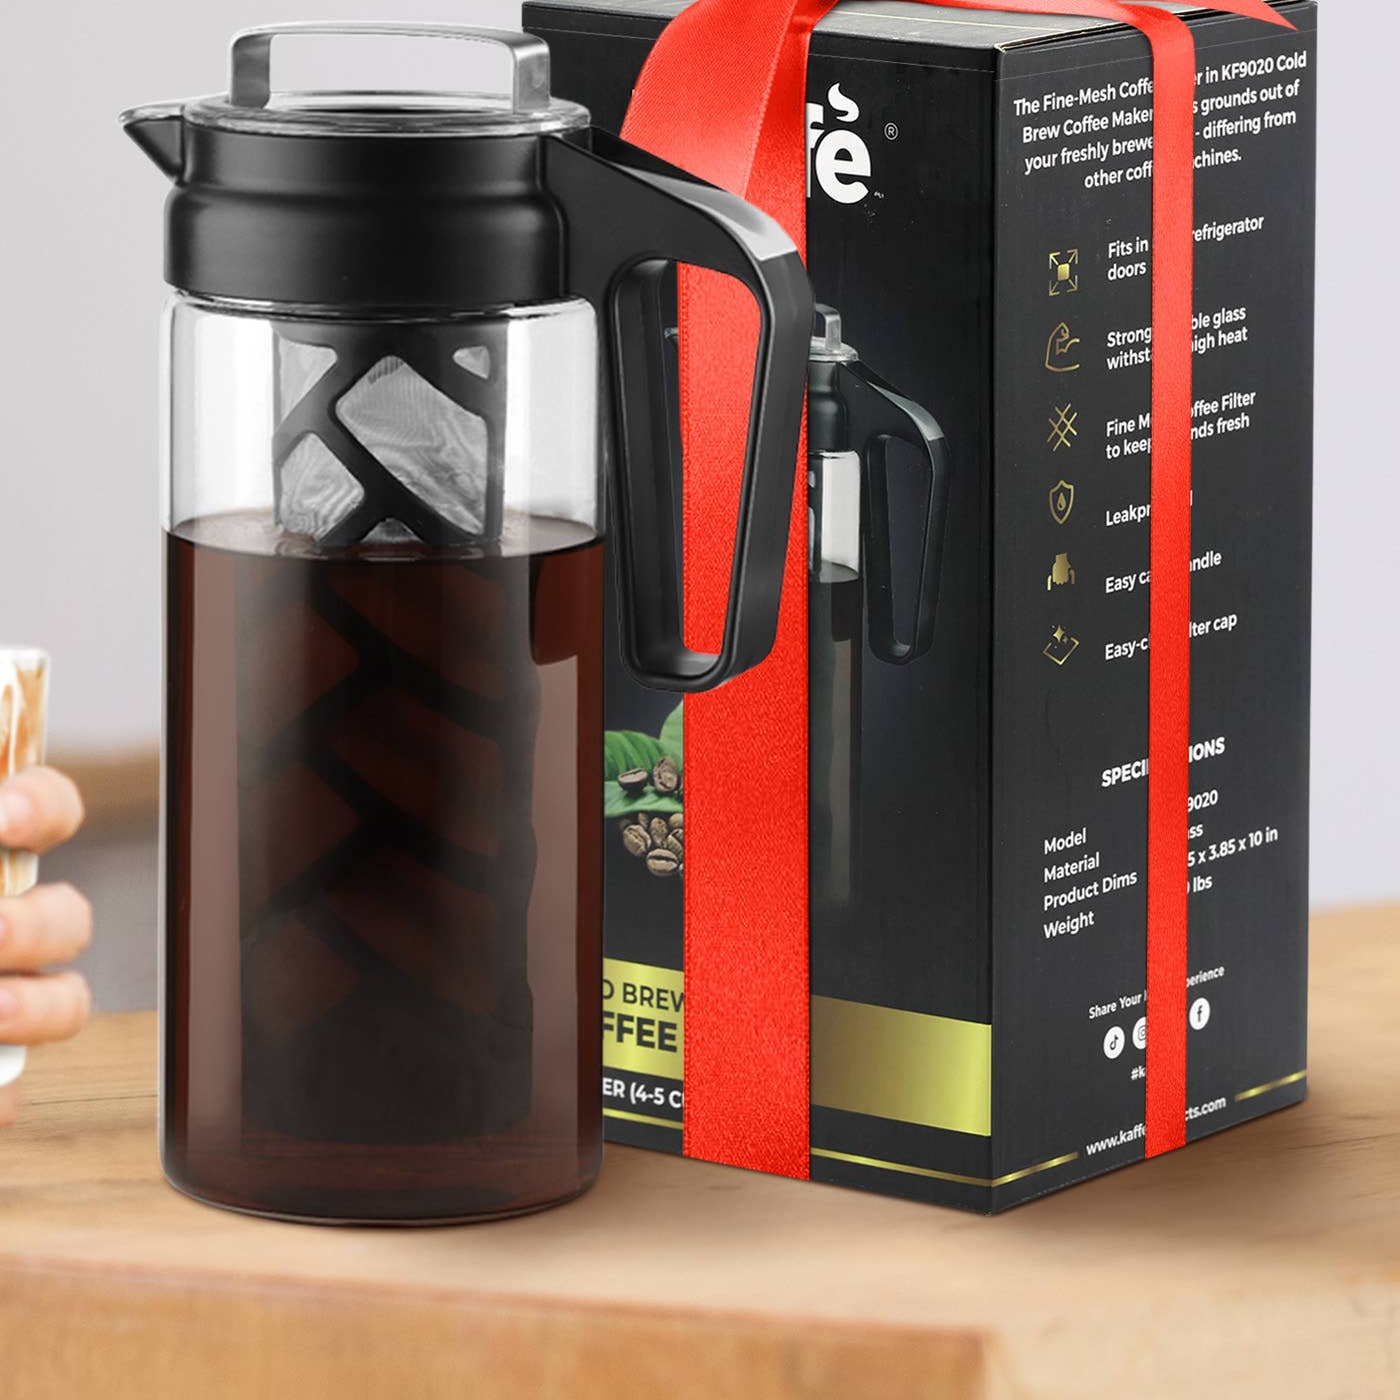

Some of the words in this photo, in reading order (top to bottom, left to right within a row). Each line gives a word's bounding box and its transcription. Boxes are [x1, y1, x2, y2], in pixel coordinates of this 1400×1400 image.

[1013, 97, 1041, 117] The
[1043, 83, 1117, 112] Fine-Mesh
[1118, 74, 1153, 98] Coffe
[1205, 65, 1219, 84] in
[1221, 56, 1275, 82] KF9020
[1276, 49, 1307, 72] Cold
[1022, 124, 1062, 144] Brew
[1062, 114, 1110, 136] Coffee
[1200, 86, 1258, 117] grounds
[1259, 83, 1284, 102] out
[1284, 78, 1301, 98] of
[1024, 152, 1059, 176] your
[1060, 141, 1110, 165] freshly
[1111, 132, 1153, 156] brewe
[1202, 114, 1262, 140] differing
[1263, 110, 1297, 129] from
[1084, 168, 1124, 189] other
[1125, 159, 1153, 180] coff
[1192, 146, 1242, 169] chines.
[1108, 239, 1134, 259] Fits
[1135, 236, 1149, 254] in
[1107, 261, 1147, 281] doors
[1106, 324, 1152, 349] Strong
[1212, 307, 1247, 330] glass
[1106, 347, 1152, 371] withst
[1192, 337, 1215, 354] igh
[1217, 326, 1248, 347] heat
[1105, 444, 1121, 460] to
[1216, 411, 1250, 435] fresh
[1106, 418, 1136, 438] Fine
[1221, 391, 1257, 412] Filter
[1105, 502, 1152, 527] Leakpr
[1105, 573, 1137, 594] Easy
[1212, 613, 1238, 632] cap
[1043, 827, 1087, 855] Model
[1043, 881, 1100, 912] Product
[1102, 871, 1138, 894] Dims
[1208, 837, 1237, 861] 3.85
[1248, 830, 1264, 848] 10
[1265, 826, 1279, 844] in
[1044, 851, 1100, 883] Material
[1043, 910, 1095, 939] Weight
[1192, 875, 1213, 893] lbs
[1088, 1001, 1118, 1020] Share
[1118, 993, 1143, 1009] Your
[629, 1081, 665, 1106] (4-5
